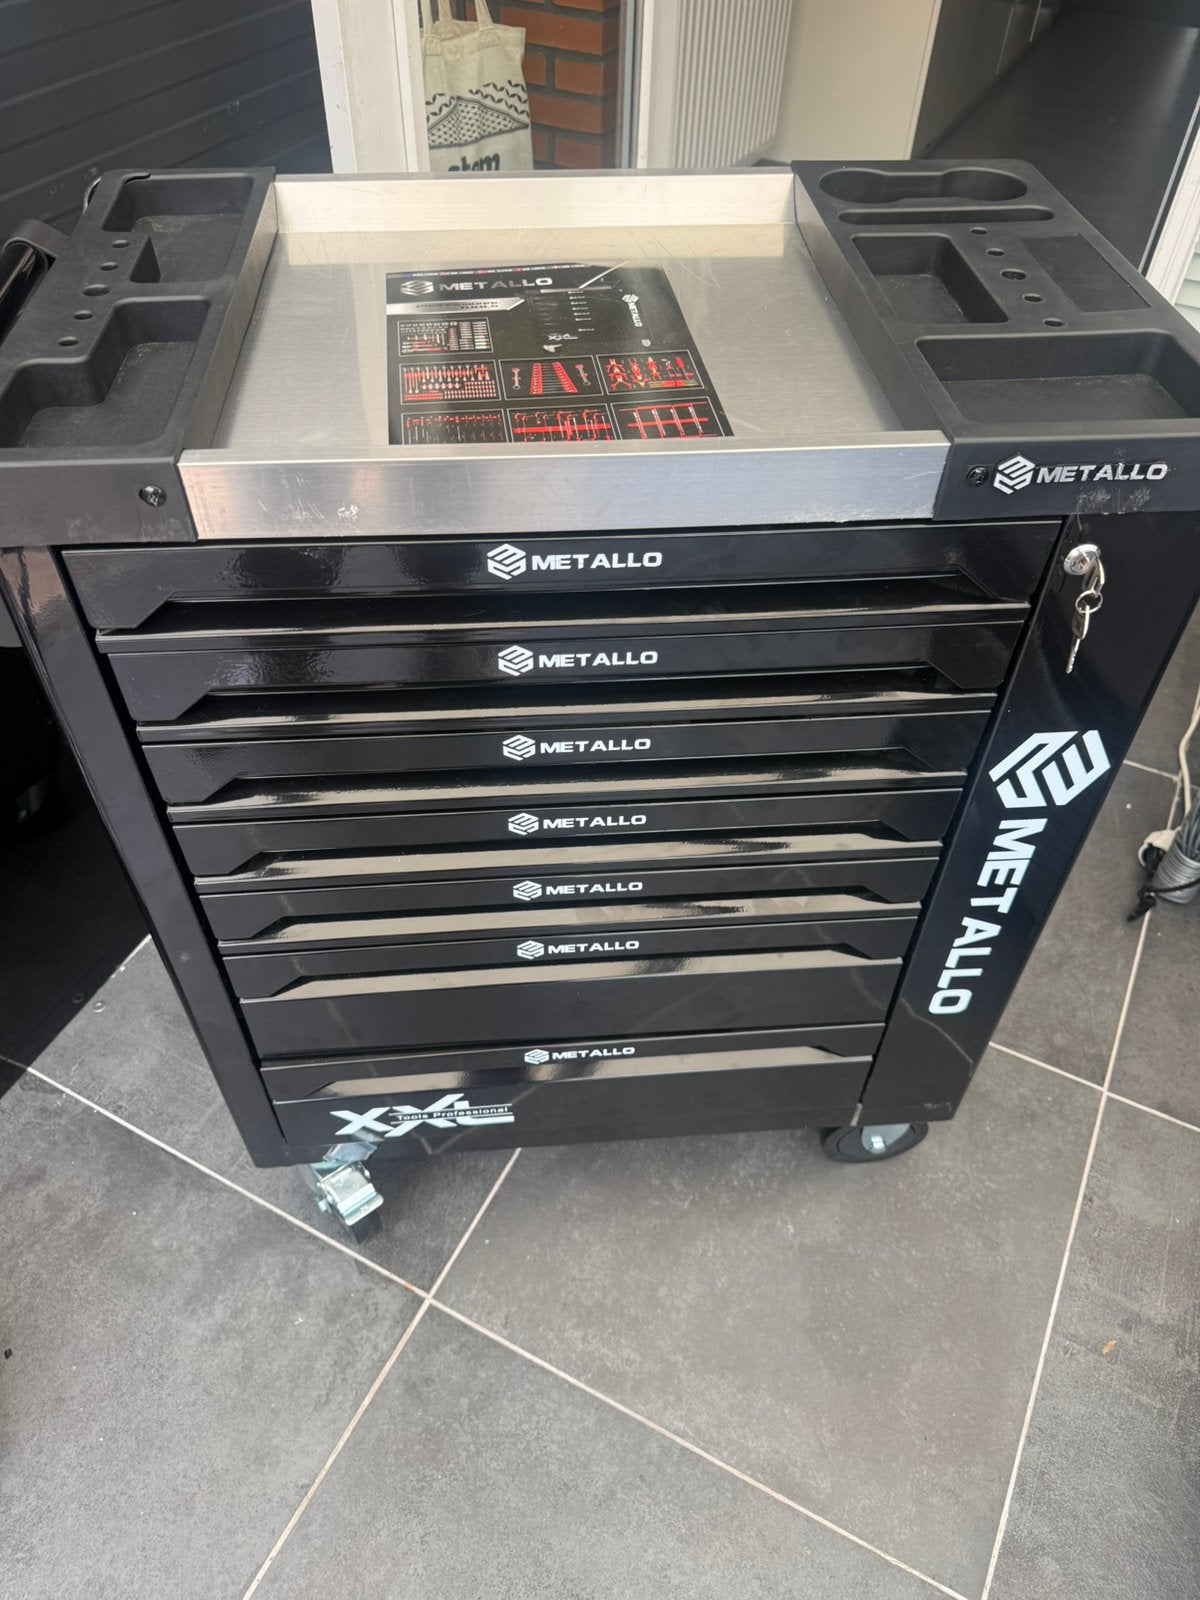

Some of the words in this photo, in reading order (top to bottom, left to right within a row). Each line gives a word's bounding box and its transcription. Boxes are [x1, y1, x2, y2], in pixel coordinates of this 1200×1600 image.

[439, 277, 553, 291] METALLO
[1036, 463, 1168, 484] METALLO
[531, 552, 663, 571] METALLO
[538, 651, 658, 668] METALLO
[540, 738, 651, 754] METALLO
[542, 814, 647, 829] METALLO
[545, 881, 643, 896] METALLO
[928, 818, 1048, 1015] METALLO
[547, 940, 640, 955] METALLO
[552, 1046, 635, 1061] METALLO
[329, 1093, 515, 1138] XXL
[396, 1113, 429, 1121] Tools
[432, 1106, 508, 1119] Professional
